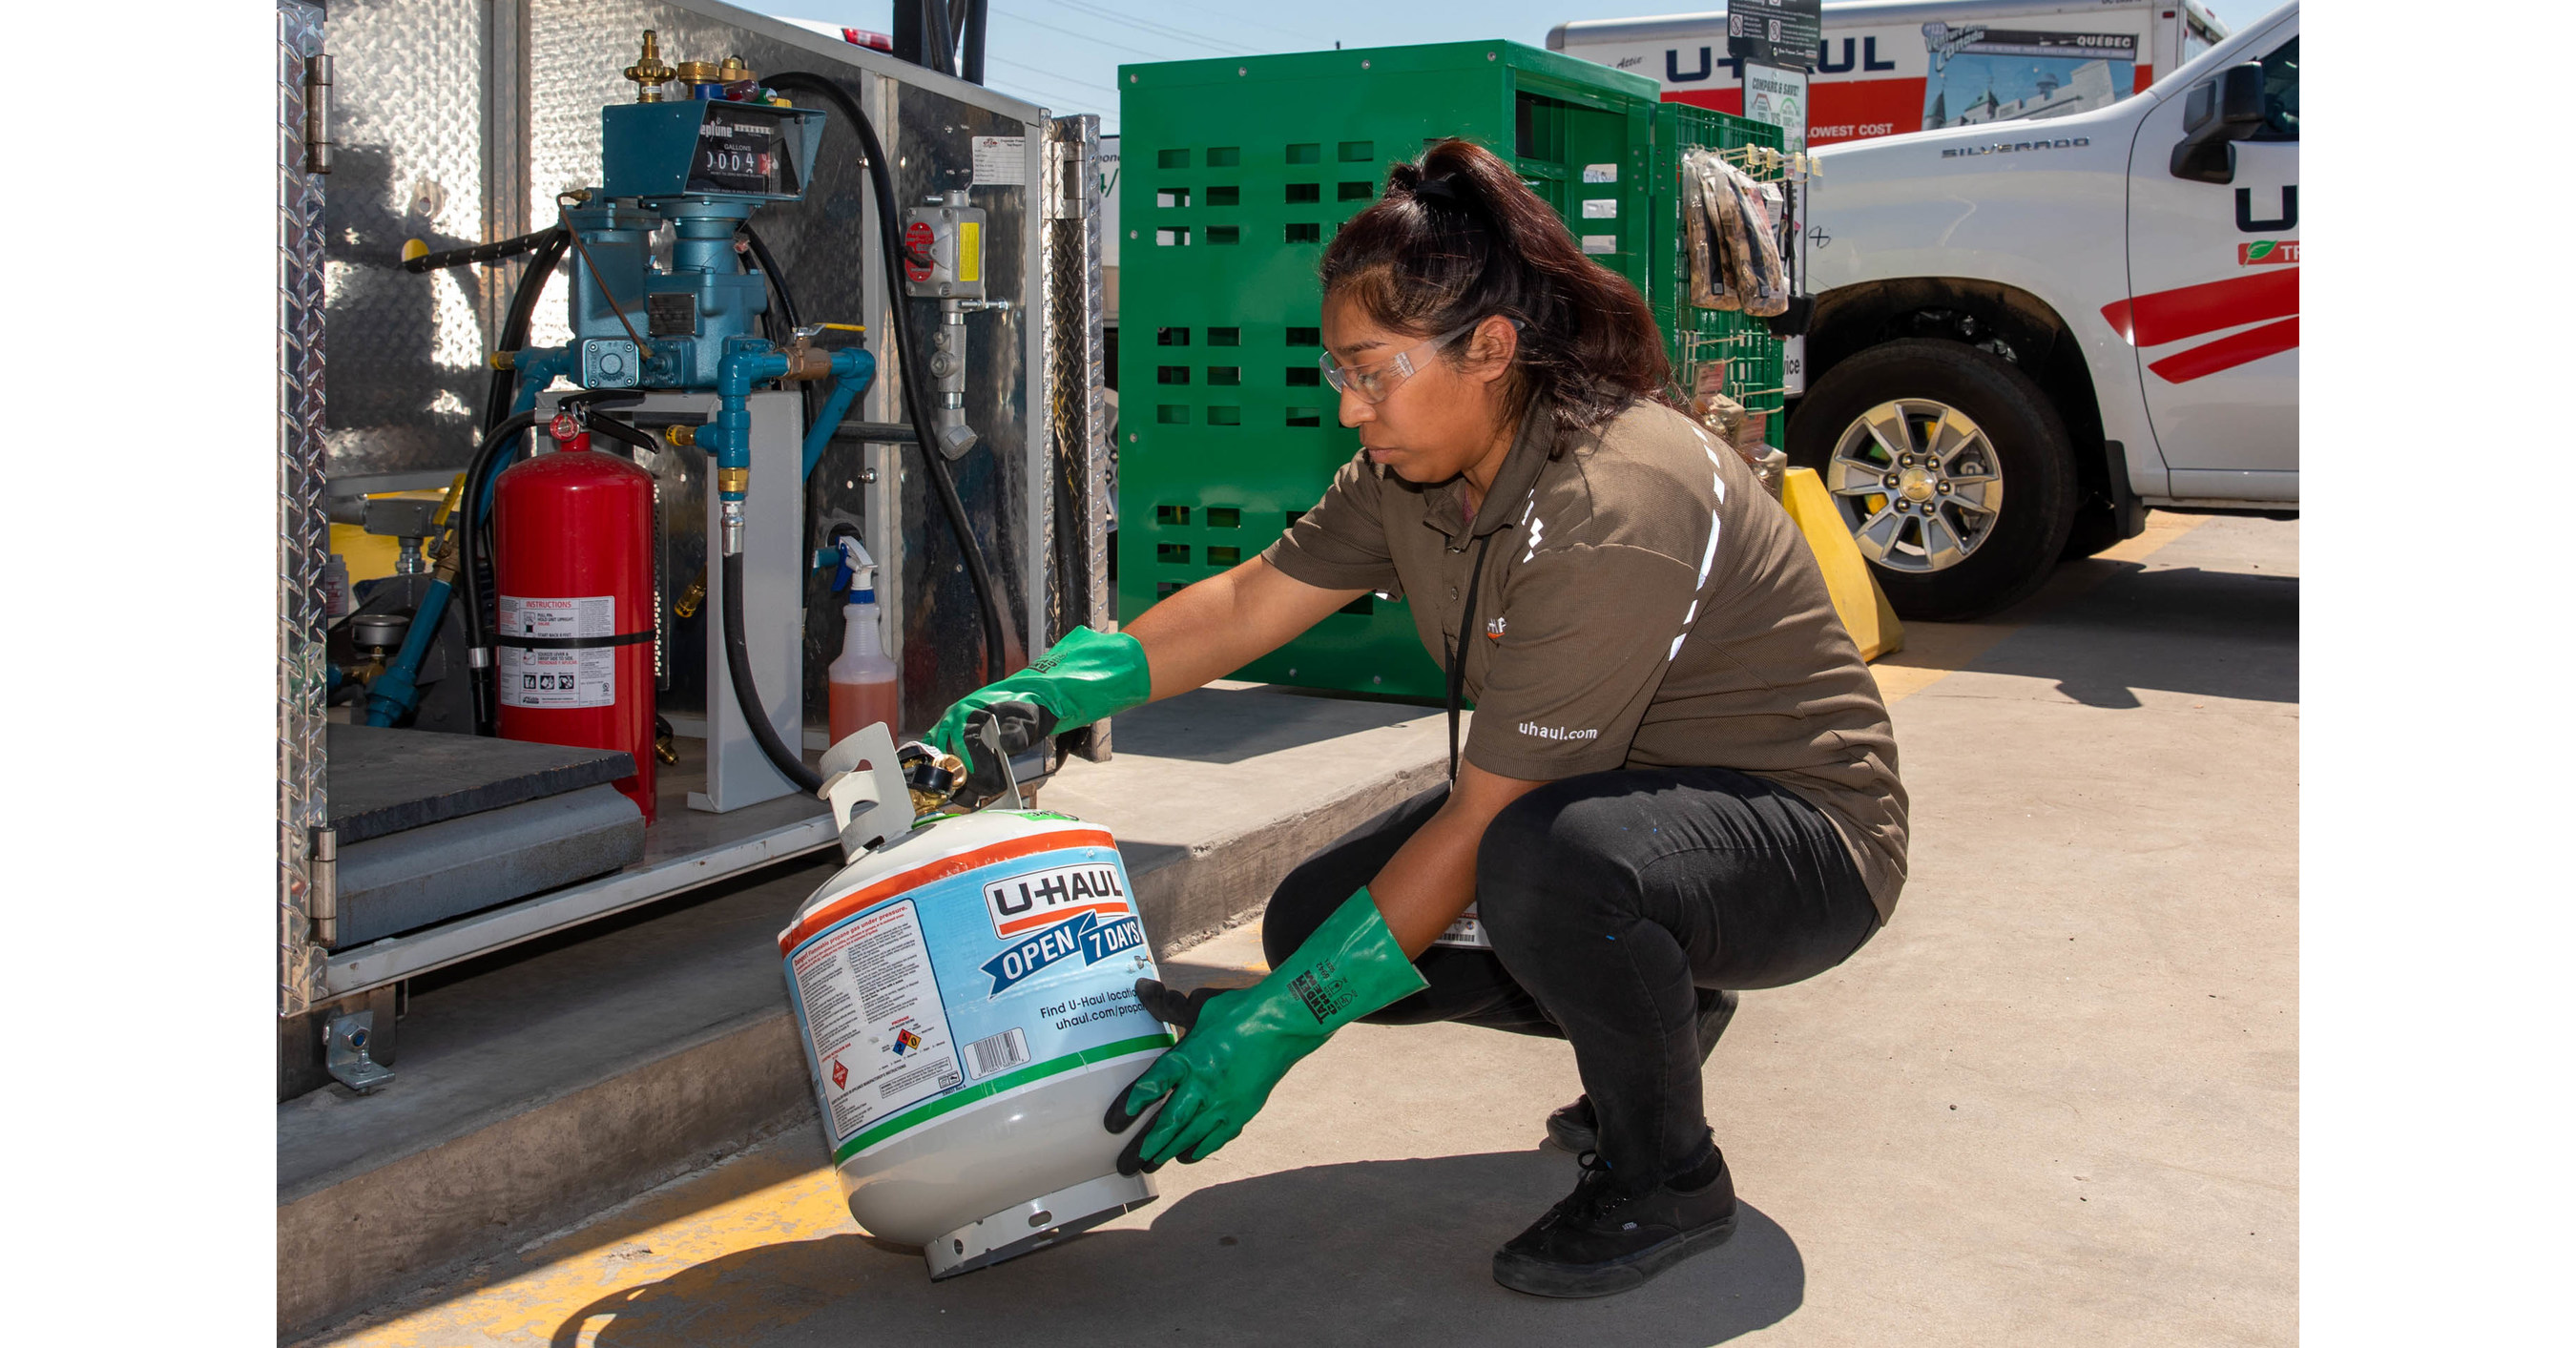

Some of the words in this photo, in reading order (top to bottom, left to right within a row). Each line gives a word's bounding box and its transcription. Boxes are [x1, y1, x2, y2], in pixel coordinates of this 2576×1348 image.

[2077, 34, 2131, 48] QUÉBEC
[1666, 36, 1896, 83] U-UL
[1753, 78, 1777, 93] COMPARE
[700, 120, 733, 142] eptune
[1859, 123, 1893, 135] COST
[1942, 136, 2091, 158] SILVERADO
[1519, 722, 1598, 740] uhaul.com
[994, 871, 1124, 916] U-HAUL
[851, 925, 861, 935] gas
[862, 918, 878, 928] under
[879, 906, 908, 922] pressure.
[1003, 925, 1075, 980] OPEN
[1089, 933, 1101, 958] 7
[1107, 921, 1141, 951] DAYS
[1041, 1003, 1066, 1019] Find
[1070, 992, 1106, 1010] U-Haul
[1292, 974, 1330, 1026] TANDEM
[1304, 970, 1338, 1015] CHEM
[1056, 1004, 1146, 1030] uhaul.com/propa
[911, 1037, 917, 1047] 0
